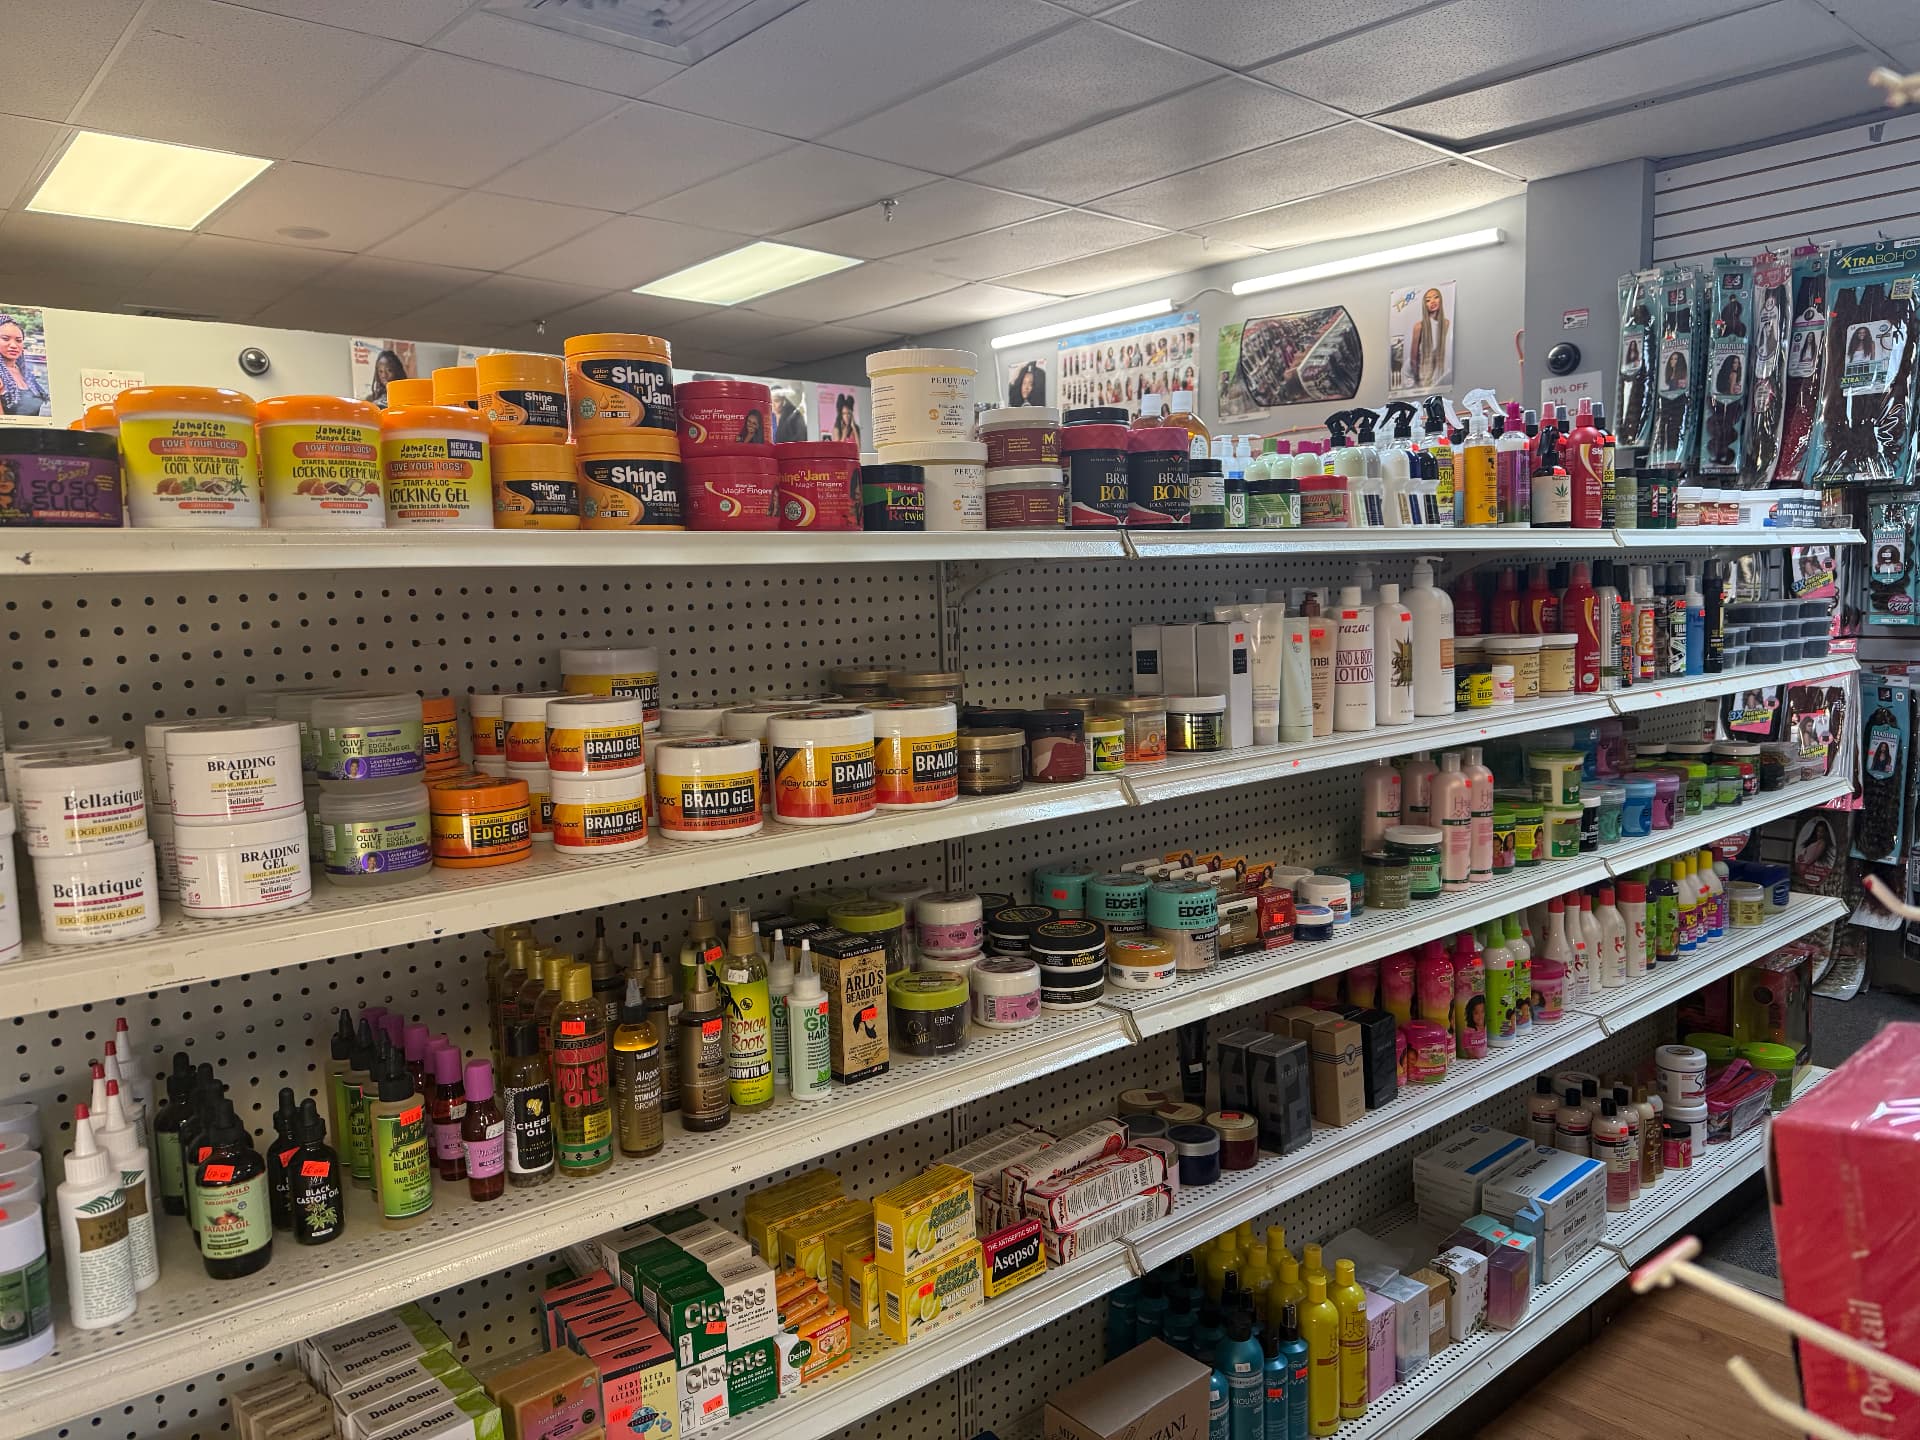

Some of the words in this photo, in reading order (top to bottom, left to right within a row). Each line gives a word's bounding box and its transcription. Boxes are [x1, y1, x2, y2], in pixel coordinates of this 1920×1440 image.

[84, 377, 143, 388] CROCHET
[612, 366, 664, 392] Shine
[1570, 383, 1588, 391] OFF
[525, 392, 553, 404] Shine
[641, 385, 672, 406] Jam
[540, 404, 558, 412] Jam
[712, 413, 745, 421] Fingers
[173, 420, 226, 431] Jamaican
[316, 425, 362, 436] Jamaican
[162, 440, 185, 448] LOVE
[189, 440, 213, 448] YOUR
[400, 444, 444, 452] Jamaican
[450, 442, 468, 450] NEW!
[450, 449, 481, 459] IMPROVED
[165, 463, 189, 474] COOL
[193, 463, 221, 474] SCALP
[292, 466, 337, 479] LOCKING
[340, 466, 369, 479] CREME
[390, 463, 409, 471] LOVE
[410, 462, 434, 470] YOUR
[611, 466, 666, 492] Shine
[804, 472, 830, 481] Jam
[32, 480, 64, 495] SO
[70, 481, 98, 497] SO
[531, 482, 560, 494] Shine
[641, 486, 676, 503] Jam
[390, 488, 441, 503] LOCKING
[445, 488, 470, 502] GEL
[546, 493, 566, 502] Jam
[32, 496, 98, 511] SLICK
[1793, 580, 1805, 592] 3X
[1338, 624, 1370, 633] razac
[1335, 667, 1374, 681] LOTION
[339, 739, 365, 748] OLIVE
[587, 739, 624, 754] BRAID
[626, 736, 640, 751] GEL
[207, 755, 276, 772] BRAIDING
[832, 753, 851, 761] LOCKS
[916, 751, 953, 771] BRAID
[228, 769, 259, 781] GEL
[835, 764, 874, 783] BRAID
[885, 767, 909, 776] LOCKS
[803, 779, 828, 787] LOCKS
[64, 789, 144, 811] Bellatique
[228, 795, 264, 805] Bellatique
[684, 791, 729, 808] BRAID
[732, 788, 754, 805] GEL
[586, 816, 624, 830] BRAID
[626, 812, 641, 826] GEL
[101, 823, 127, 835] BRAID
[473, 824, 510, 842] EDGE
[511, 819, 529, 838] GEL
[356, 833, 382, 842] OLIVE
[240, 843, 300, 863] BRAIDING
[262, 857, 288, 870] GEL
[53, 877, 143, 900] Bellatique
[260, 883, 293, 895] Bellatique
[1106, 898, 1137, 909] EDGE
[85, 911, 117, 922] BRAID
[126, 906, 143, 917] LOC
[1178, 905, 1210, 917] EDGE
[846, 970, 884, 993] ARLO'S
[846, 989, 870, 1003] BEARD
[872, 987, 883, 998] OIL
[808, 1029, 827, 1040] HAIR
[557, 1067, 584, 1089] HOT
[730, 1067, 759, 1079] GROWTH
[564, 1089, 603, 1108] OIL
[393, 1161, 416, 1171] BLACK
[297, 1194, 327, 1205] CASTOR
[328, 1188, 340, 1198] OIL
[305, 1184, 330, 1197] BLACK
[235, 1221, 250, 1229] OIL
[934, 1224, 954, 1240] LEMON
[953, 1213, 970, 1229] SOAP
[998, 1231, 1026, 1248] ANTISEPTIC
[1025, 1223, 1039, 1235] SOAP
[960, 1282, 978, 1297] SOAP
[685, 1287, 766, 1329] Clovate
[332, 1322, 398, 1352] Dudu-Osun
[344, 1341, 412, 1374] Dudu-Osun
[789, 1346, 811, 1362] Dettol
[686, 1349, 767, 1395] Clovate
[349, 1366, 418, 1402] Dudu-Osun
[618, 1371, 663, 1392] MEDICATED
[368, 1386, 440, 1420] Dudu-Osun
